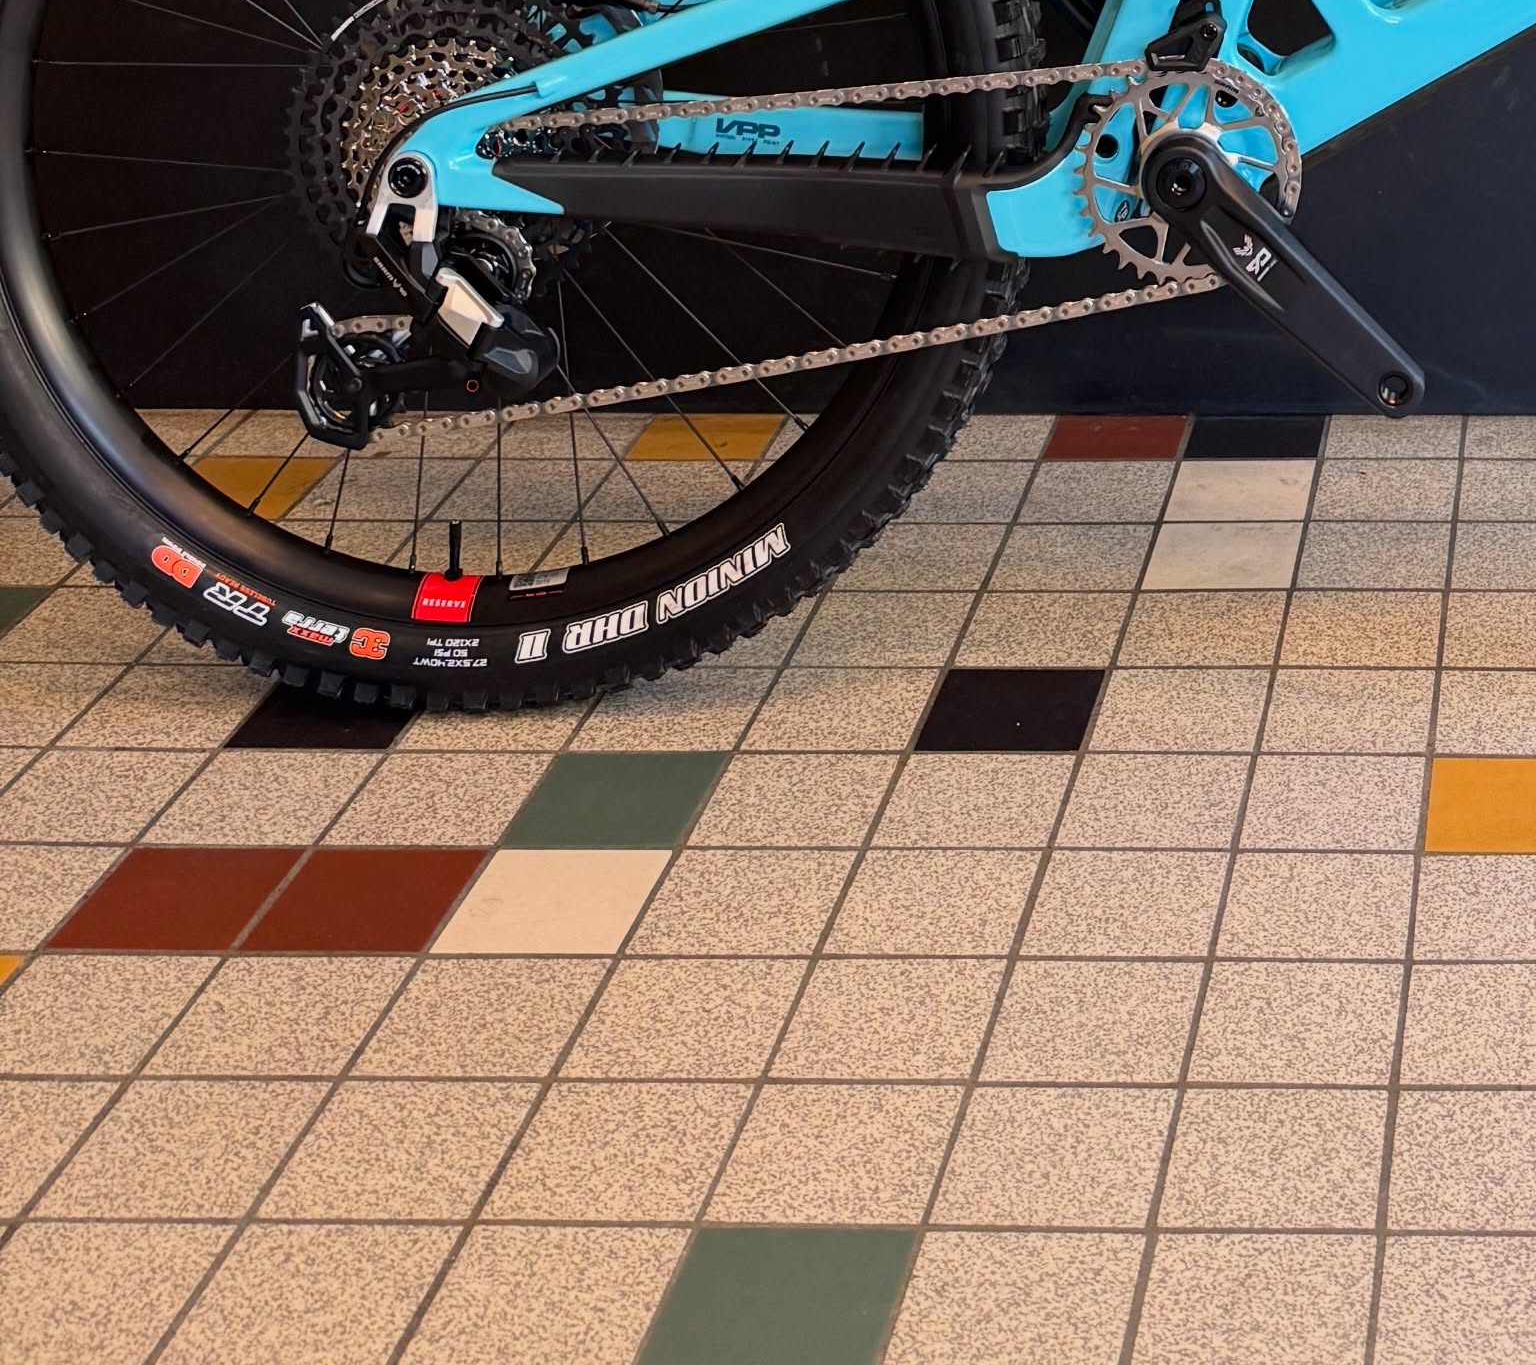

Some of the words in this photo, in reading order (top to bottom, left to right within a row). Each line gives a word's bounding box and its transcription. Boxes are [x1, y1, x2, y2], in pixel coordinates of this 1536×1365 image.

[716, 118, 781, 137] VPP
[656, 523, 791, 624] MINION
[203, 581, 271, 627] TR
[422, 597, 466, 609] RESERVE
[281, 610, 351, 645] terra
[286, 624, 335, 646] maxx
[562, 601, 649, 654] DHR
[427, 637, 444, 646] TPI
[445, 638, 480, 647] 2X120
[434, 648, 452, 657] PSI
[452, 648, 469, 657] 50
[412, 656, 489, 668] 27.5X2.40WT
